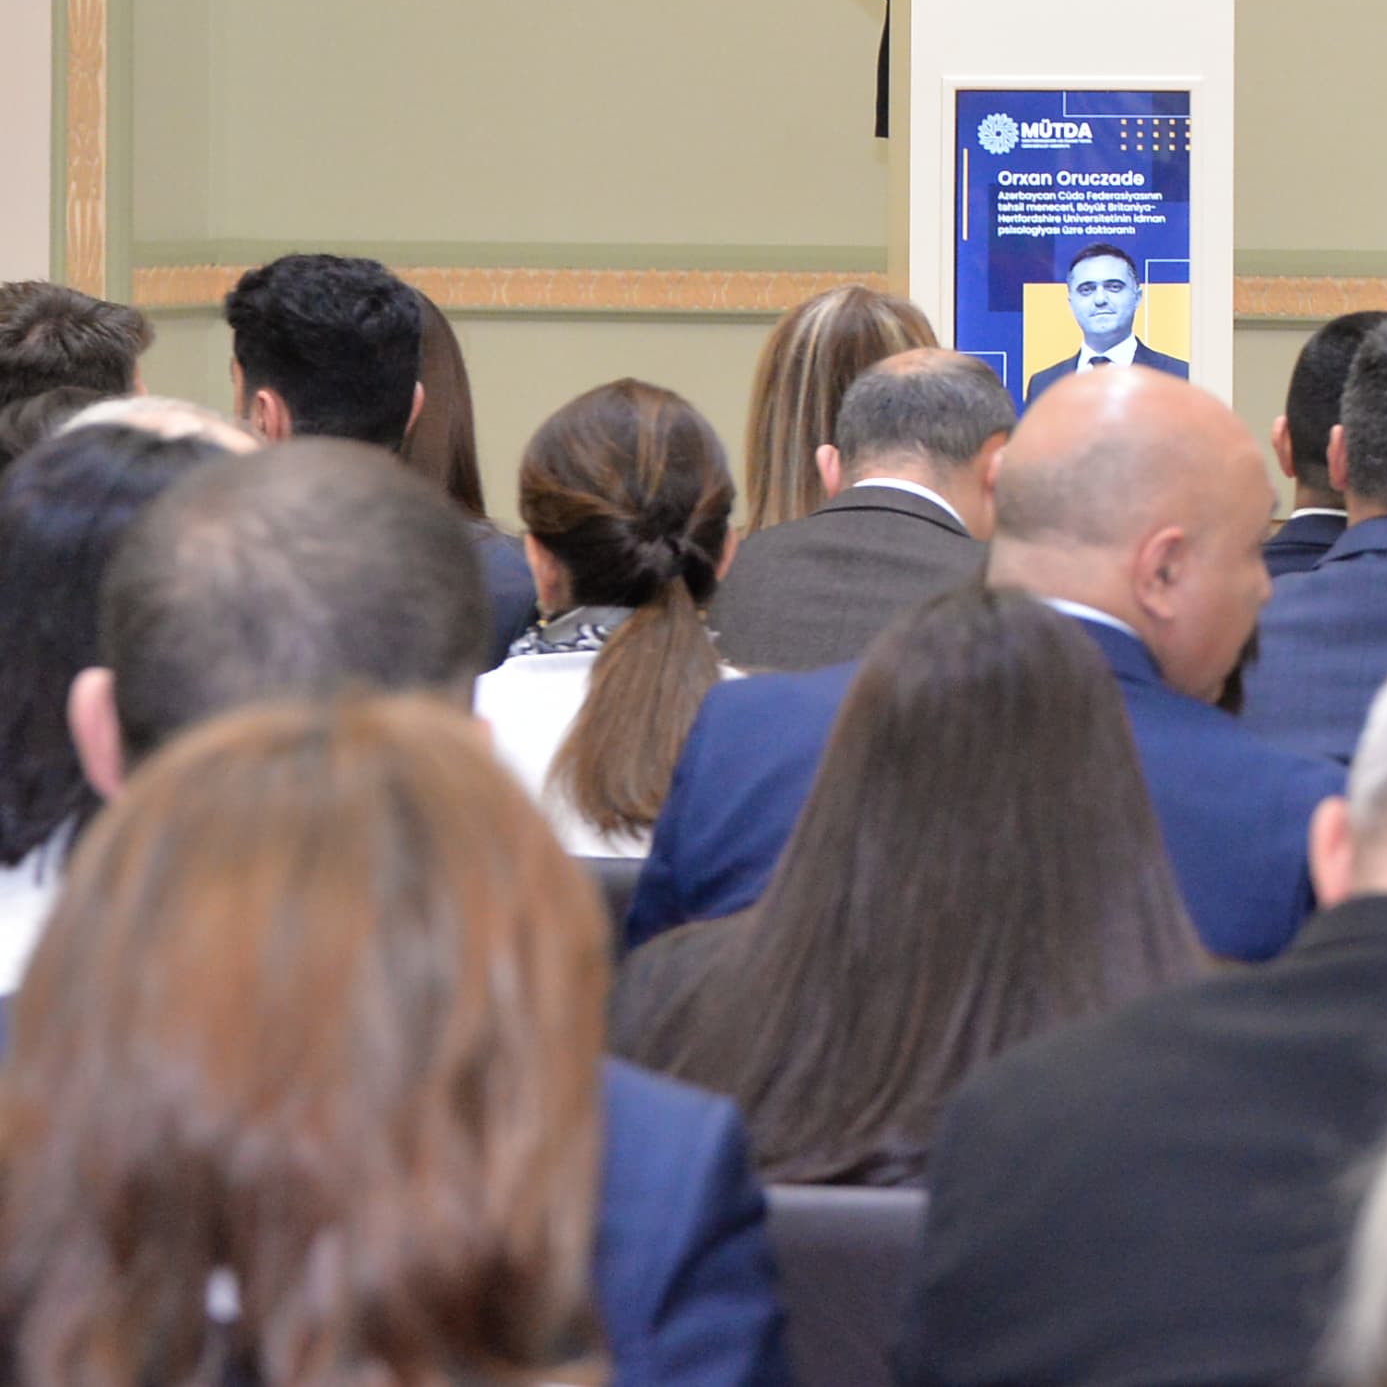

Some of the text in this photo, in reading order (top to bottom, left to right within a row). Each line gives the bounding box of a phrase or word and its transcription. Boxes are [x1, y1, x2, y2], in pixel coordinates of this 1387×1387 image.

[1021, 119, 1092, 138] MÜTDA
[998, 170, 1145, 186] Orxan Oruczadə
